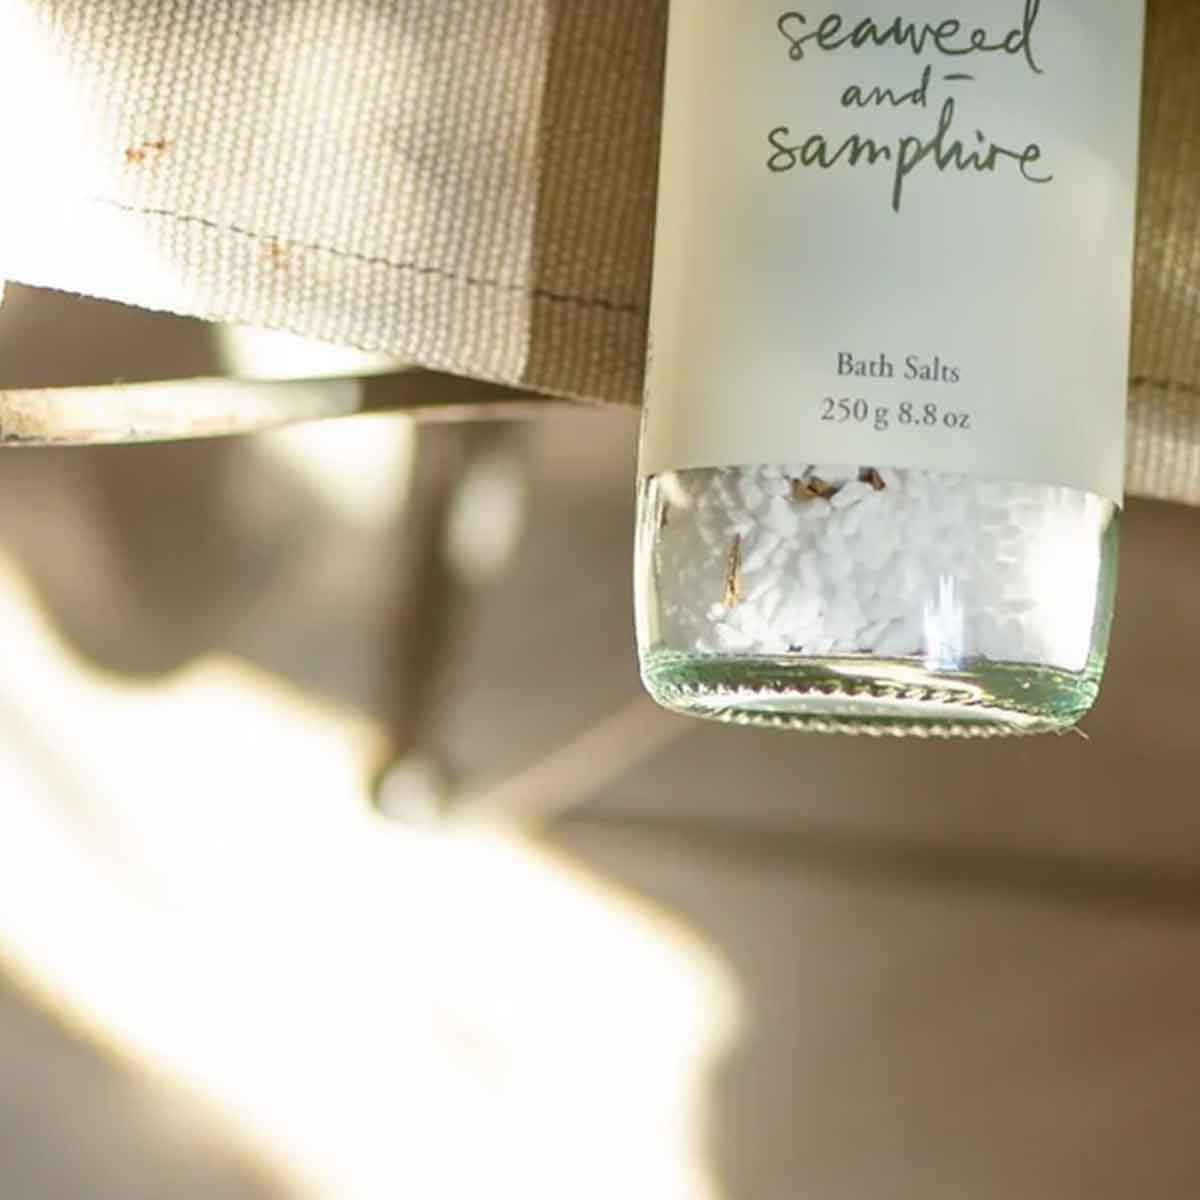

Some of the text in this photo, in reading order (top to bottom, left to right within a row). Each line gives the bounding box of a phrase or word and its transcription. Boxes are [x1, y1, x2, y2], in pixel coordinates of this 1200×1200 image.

[840, 64, 932, 107] and
[766, 96, 1053, 213] samphire
[837, 351, 960, 383] Bath Salts
[820, 397, 972, 431] 250 g 8.8 oz
